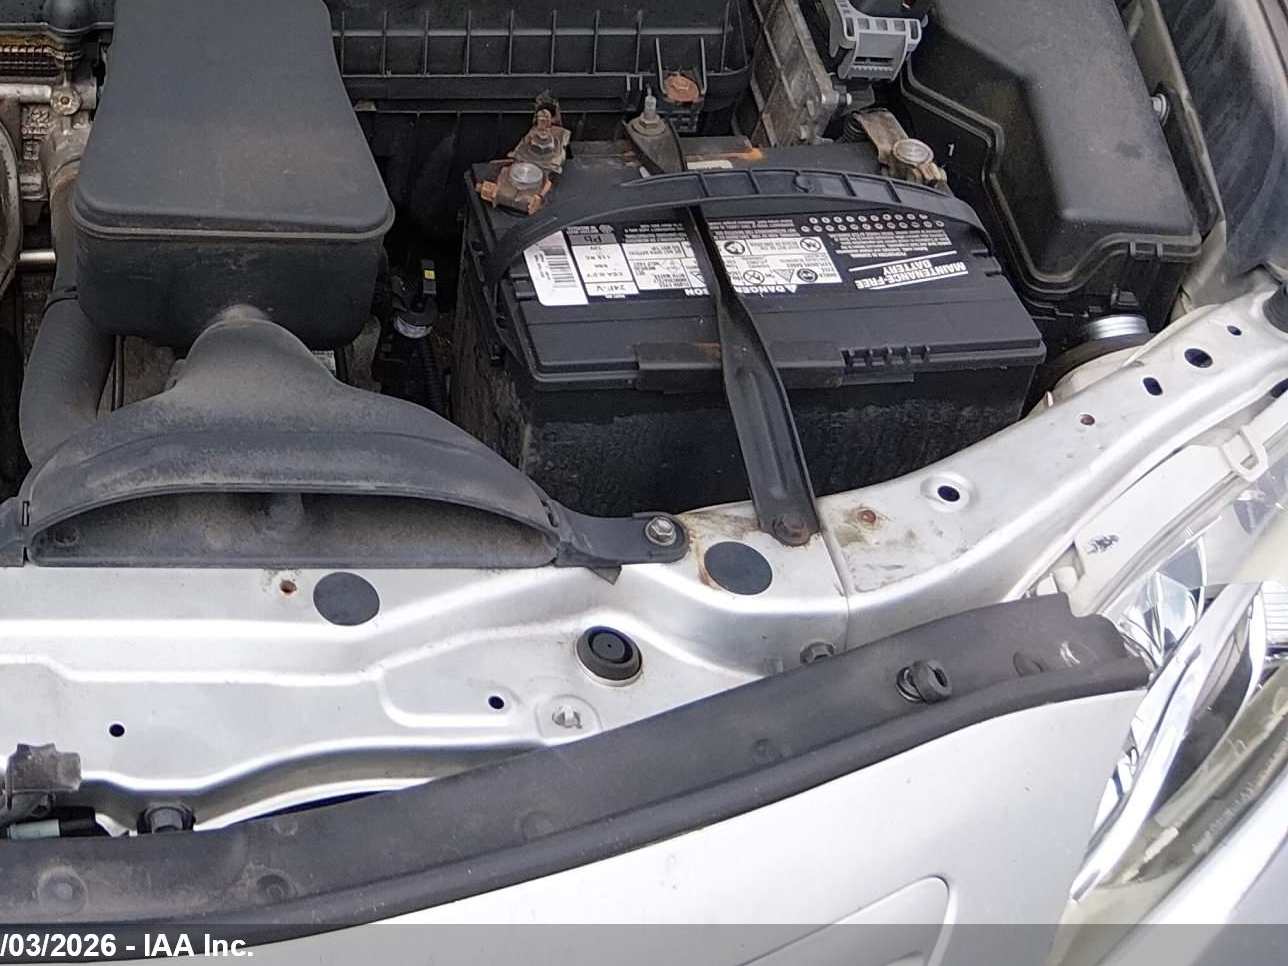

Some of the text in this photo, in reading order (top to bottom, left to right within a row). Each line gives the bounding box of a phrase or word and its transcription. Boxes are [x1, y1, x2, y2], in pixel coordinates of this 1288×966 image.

[854, 261, 967, 290] MAINTENANCE-FREE
[882, 259, 930, 276] BATTERY
[734, 284, 784, 294] DANGER
